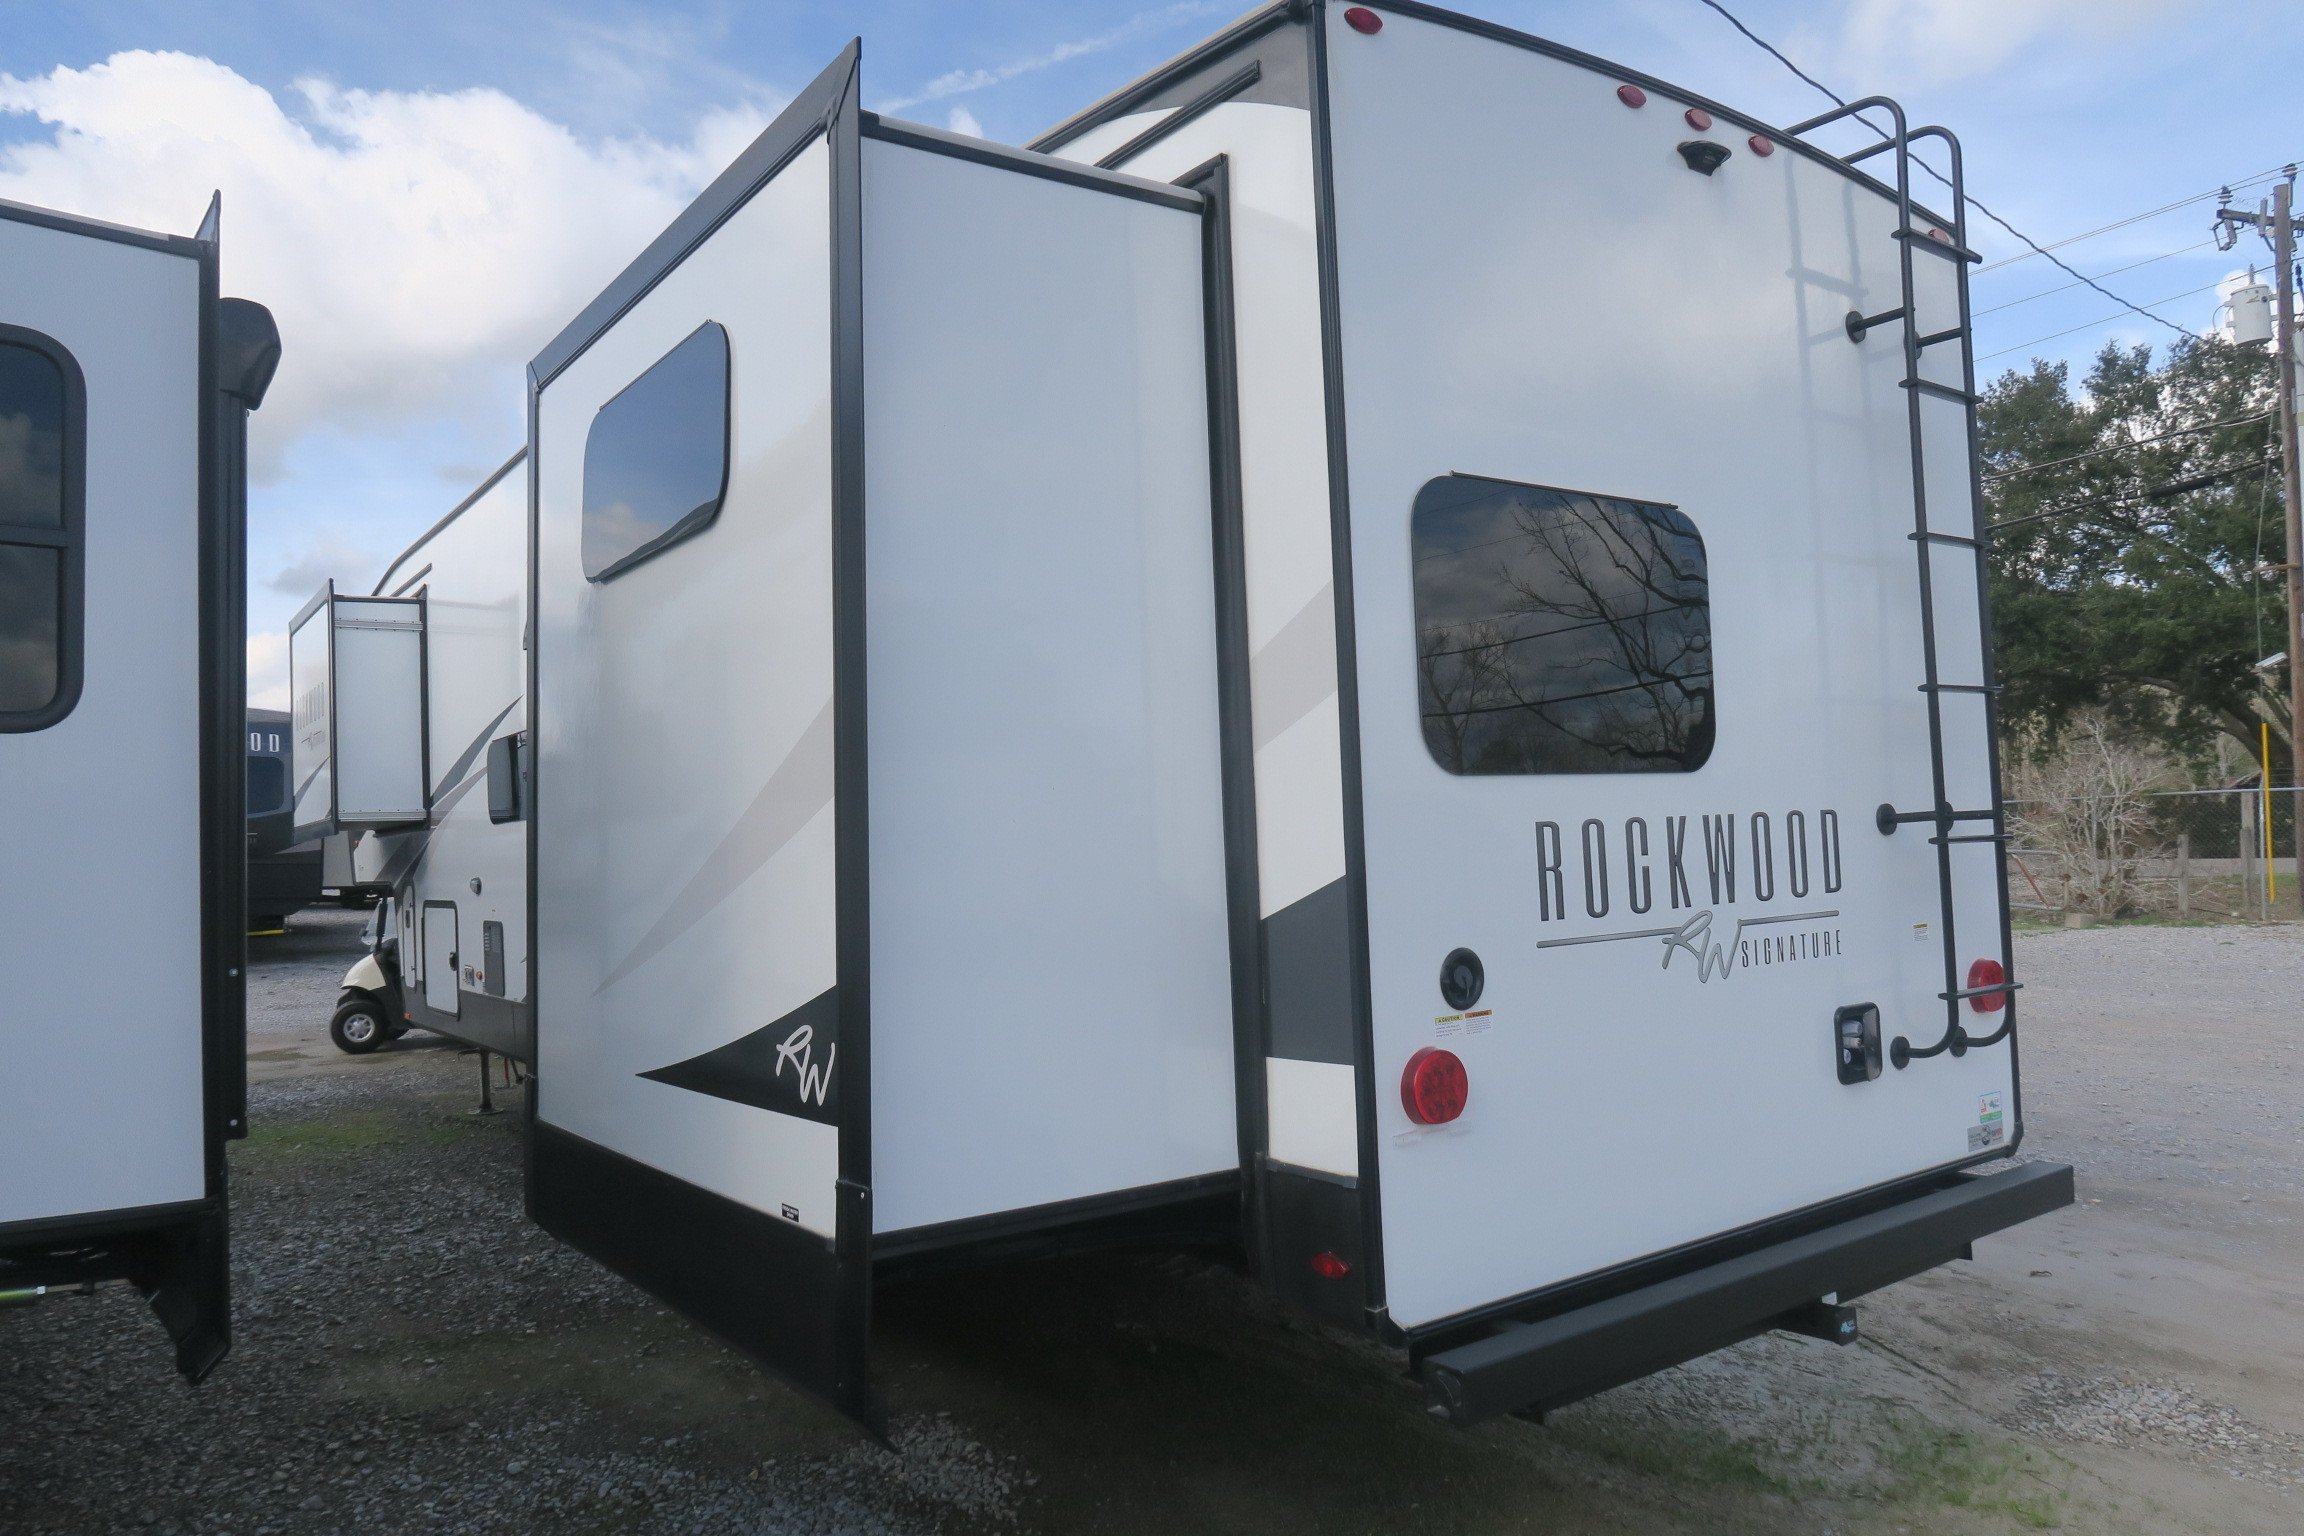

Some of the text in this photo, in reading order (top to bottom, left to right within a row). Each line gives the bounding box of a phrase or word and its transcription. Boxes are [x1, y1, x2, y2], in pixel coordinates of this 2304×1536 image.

[1535, 809, 1842, 922] ROCKWOOD
[1661, 910, 1742, 984] RW
[1741, 930, 1842, 968] SIGNATURE
[775, 1024, 836, 1107] RW
